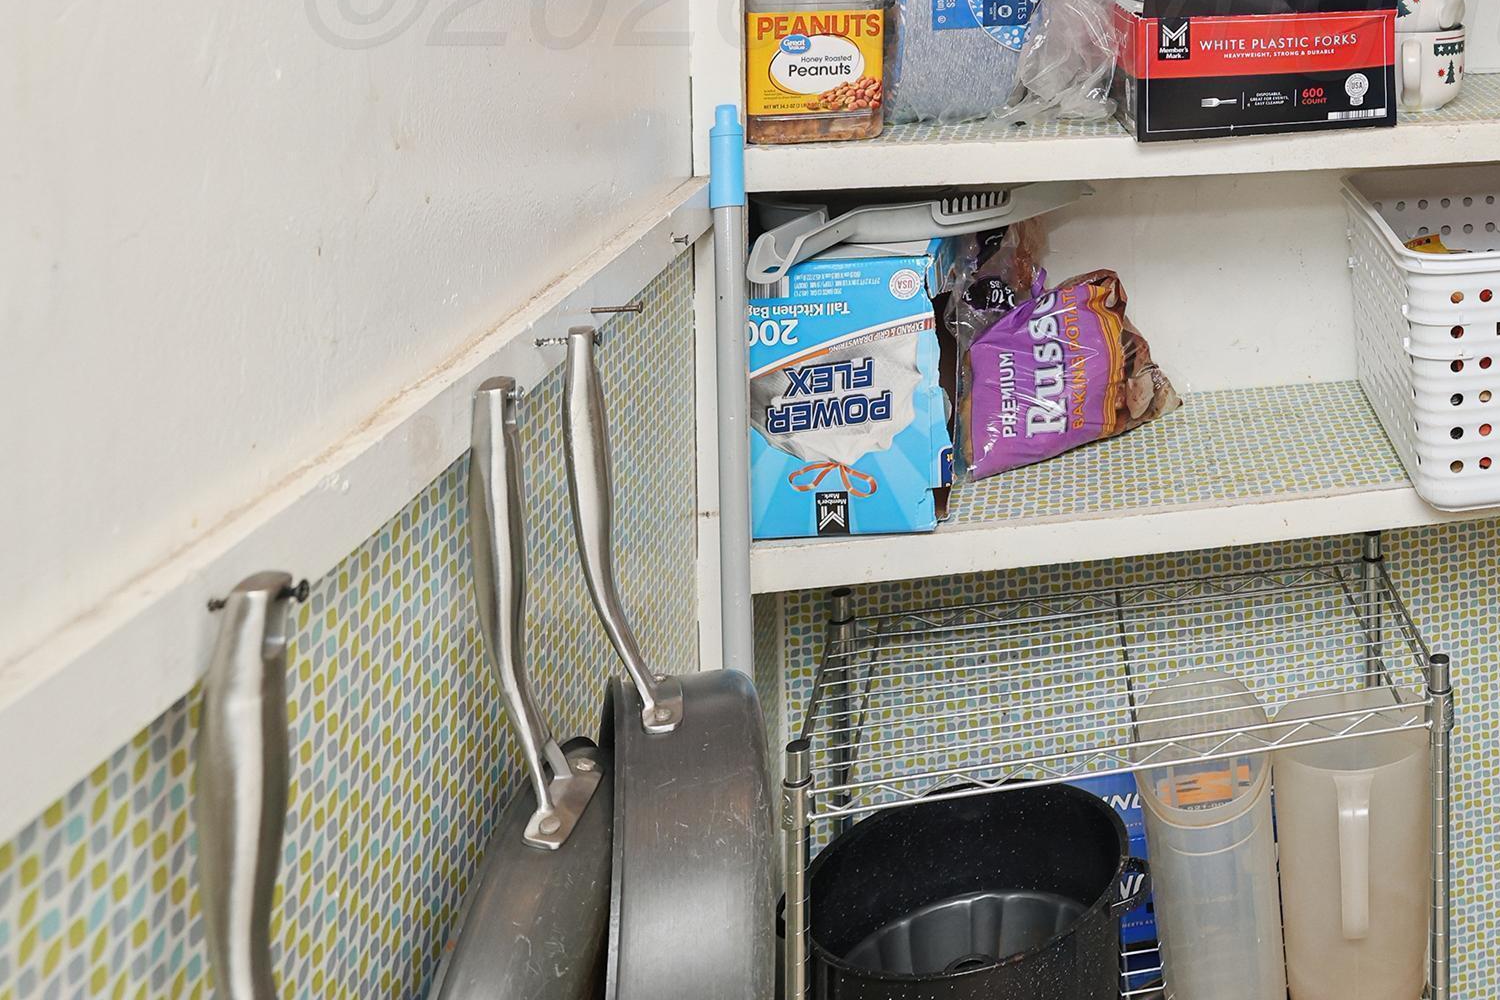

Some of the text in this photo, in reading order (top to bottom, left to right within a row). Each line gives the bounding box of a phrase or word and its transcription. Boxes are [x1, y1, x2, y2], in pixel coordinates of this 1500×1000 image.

[757, 13, 881, 41] PEANUTS
[782, 39, 807, 49] Great
[1199, 33, 1358, 52] WHITE PLASTIC FORKS
[1159, 46, 1189, 54] Member's
[1223, 48, 1335, 59] HEAVYWEIGHT, STRONG DURABLE
[800, 54, 853, 64] Honey Roasted
[788, 62, 851, 78] Peanuts
[1351, 81, 1363, 89] USA
[1302, 88, 1324, 98] 600
[896, 280, 913, 288] USA
[772, 304, 824, 316] Kitchen
[826, 302, 851, 315] Tall
[828, 321, 925, 353] EXPAND GRIP DRAWSTRING
[784, 358, 874, 398] FLEX
[1001, 352, 1017, 439] PREMIUM
[1071, 356, 1086, 430] BAKING
[766, 394, 893, 436] POWER
[818, 498, 847, 506] Member's
